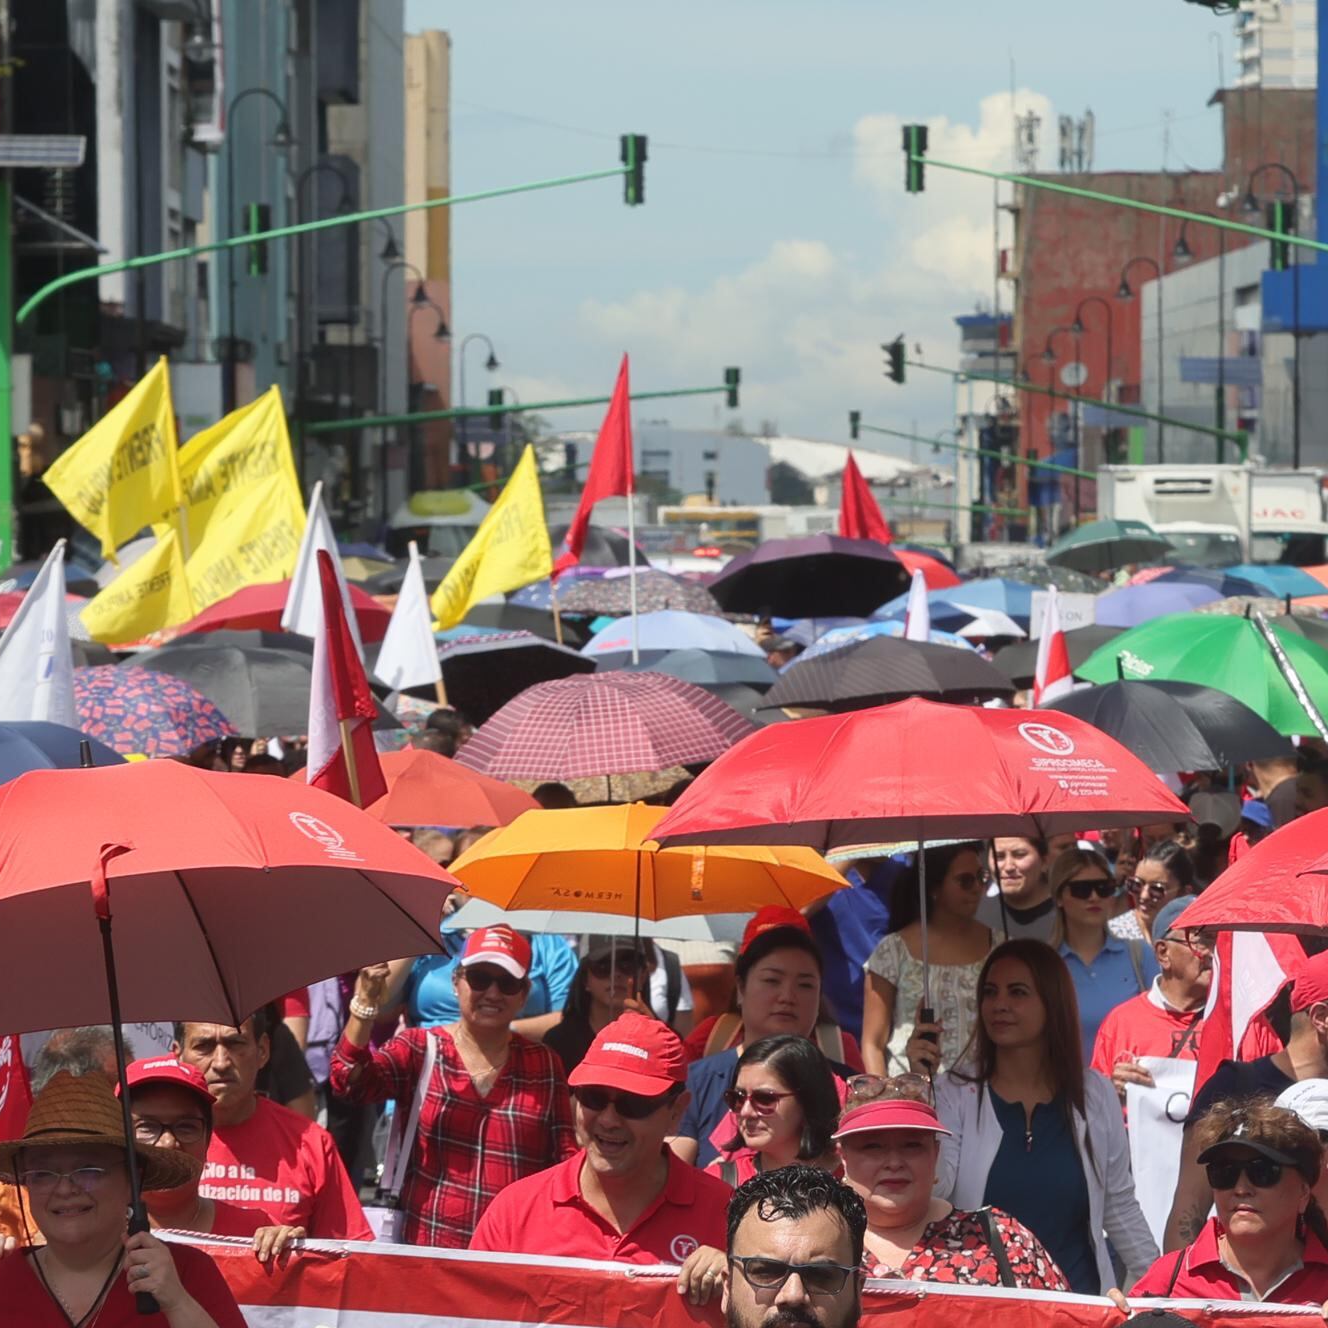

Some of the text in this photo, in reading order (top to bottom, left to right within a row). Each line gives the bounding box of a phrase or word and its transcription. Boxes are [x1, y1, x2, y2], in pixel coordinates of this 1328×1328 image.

[1255, 508, 1306, 520] JAC
[263, 1186, 282, 1203] de
[284, 1187, 300, 1204] la
